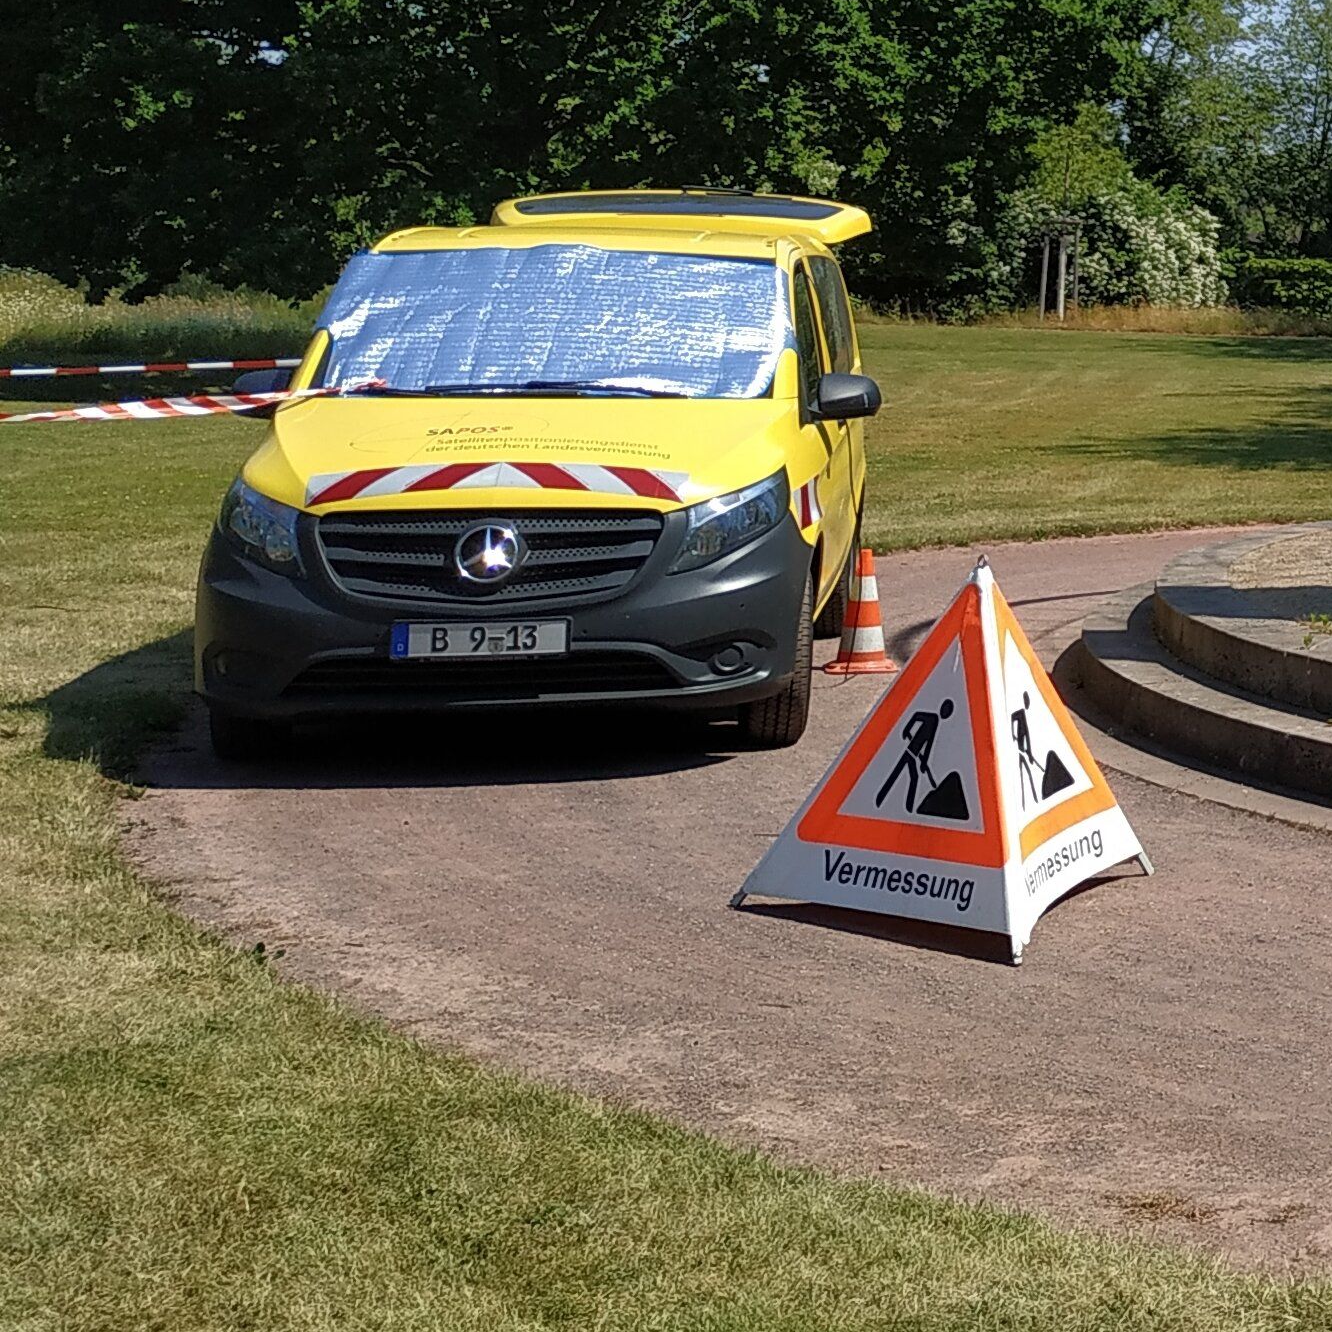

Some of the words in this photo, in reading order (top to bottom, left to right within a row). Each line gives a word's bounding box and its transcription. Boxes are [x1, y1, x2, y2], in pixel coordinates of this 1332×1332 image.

[437, 437, 659, 450] Satellitenpositionierungsdienst
[453, 442, 530, 451] deutschen
[534, 443, 671, 460] Landesvermessung
[431, 627, 449, 652] B
[824, 849, 975, 912] Vermessung
